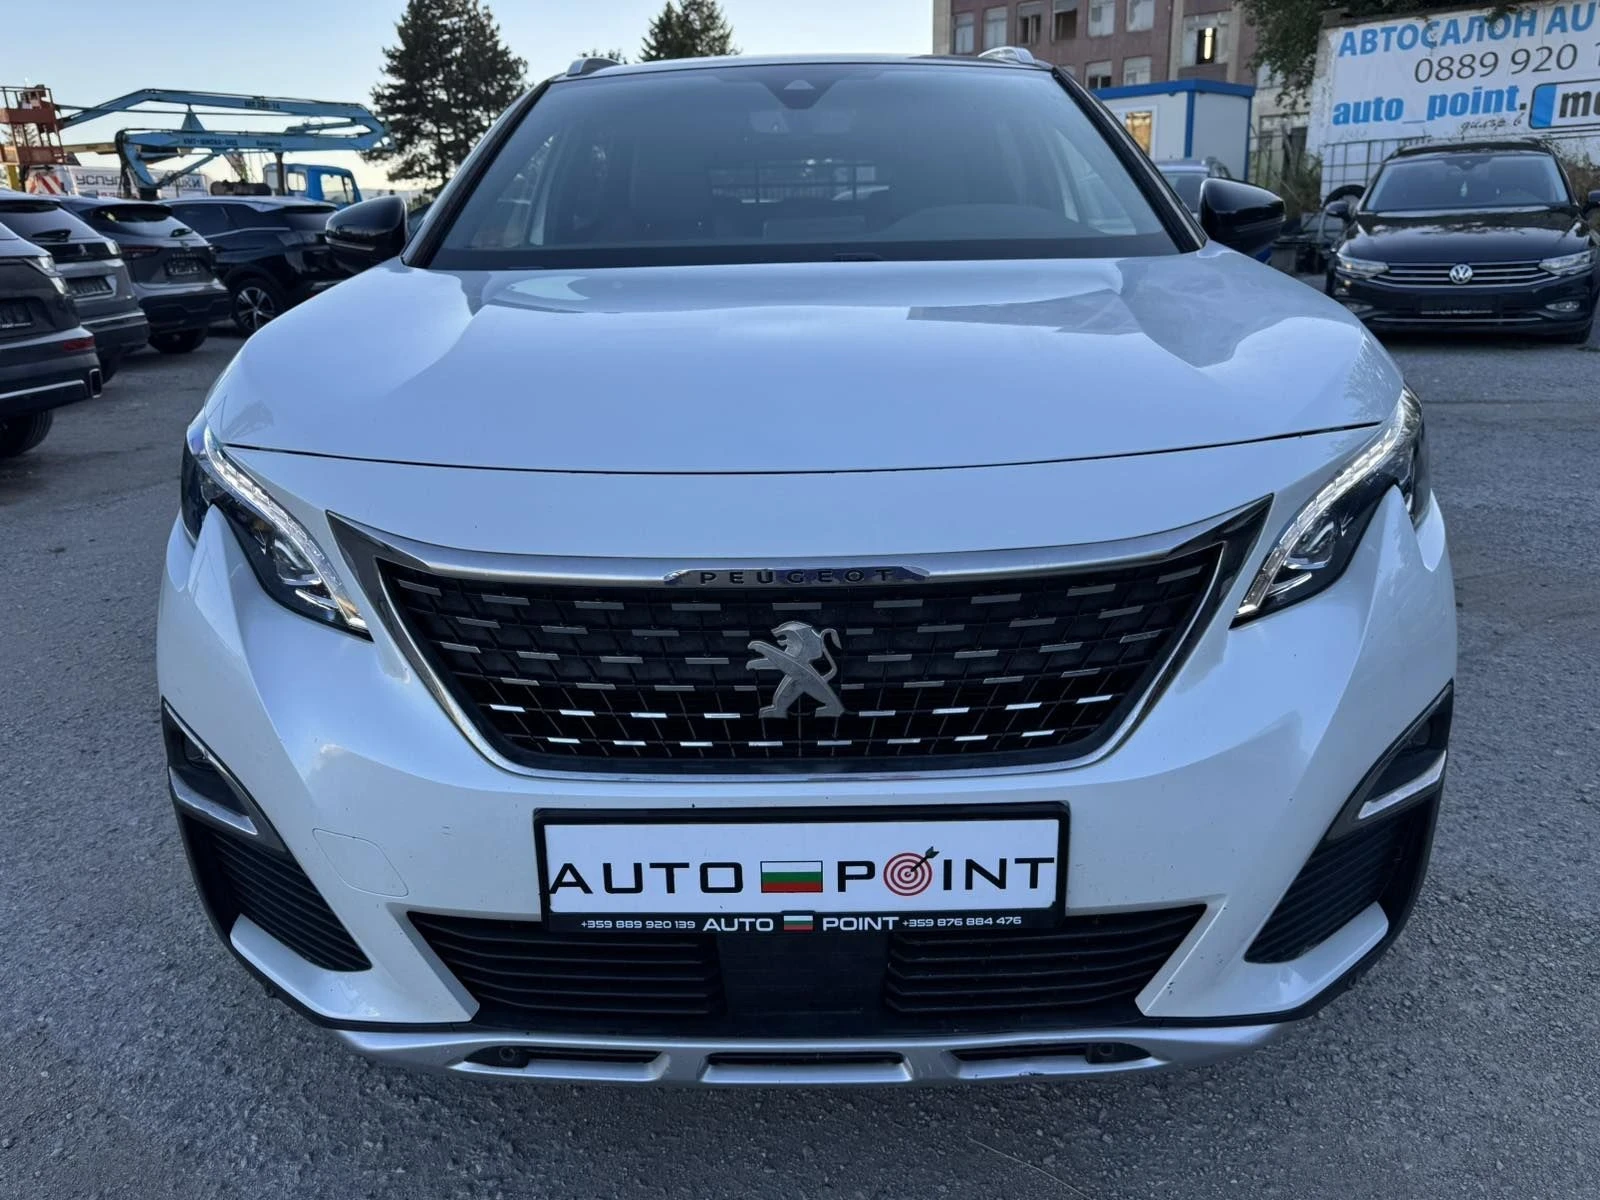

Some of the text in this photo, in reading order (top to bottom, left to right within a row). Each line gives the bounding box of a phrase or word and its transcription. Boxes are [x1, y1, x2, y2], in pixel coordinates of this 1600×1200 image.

[1338, 2, 1600, 57] АВТОСАЛОН AU
[1414, 51, 1499, 83] 0889
[1511, 43, 1578, 75] 920
[700, 568, 894, 585] PEUGEOT
[548, 862, 743, 895] AUTO
[581, 916, 1022, 932] +359 889 920 139 AUTO POINT +359 876 884 476
